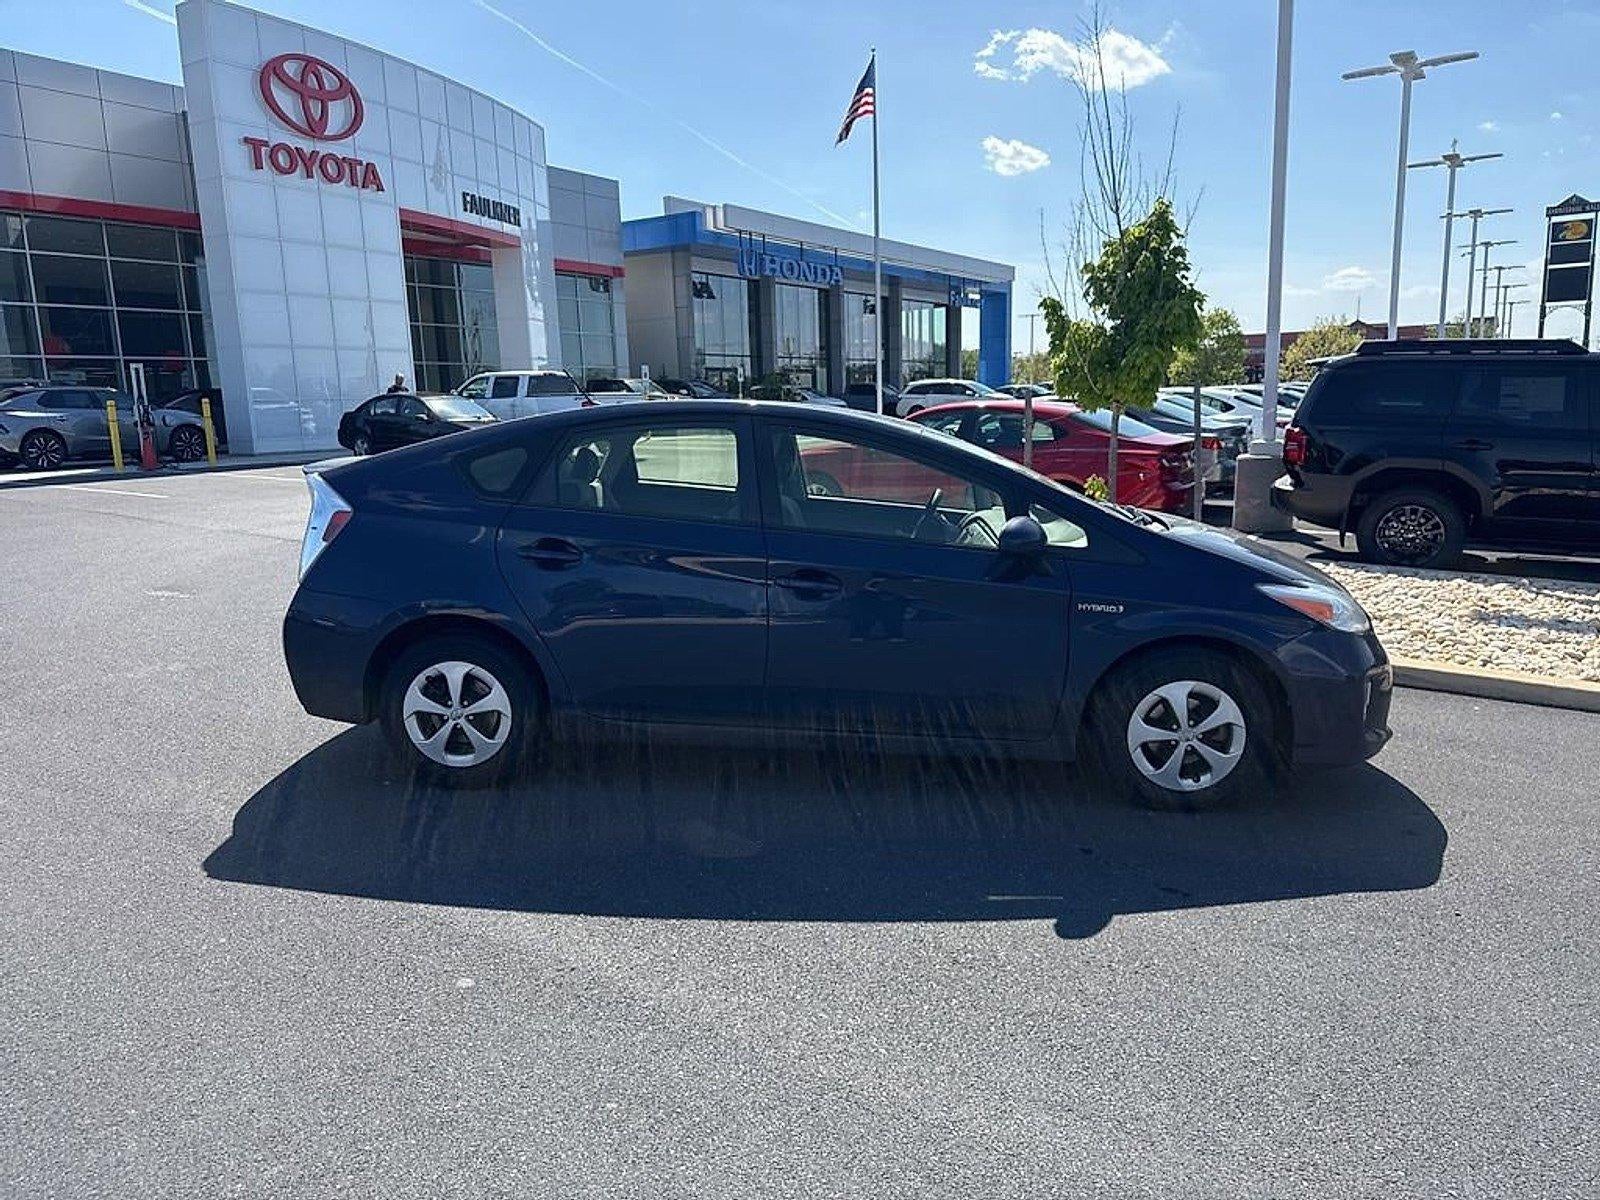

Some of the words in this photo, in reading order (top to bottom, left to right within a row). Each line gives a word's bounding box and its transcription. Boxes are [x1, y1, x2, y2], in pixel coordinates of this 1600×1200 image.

[243, 136, 385, 192] TOYOTA
[462, 191, 521, 227] FAULKNER
[762, 254, 844, 286] HONDA
